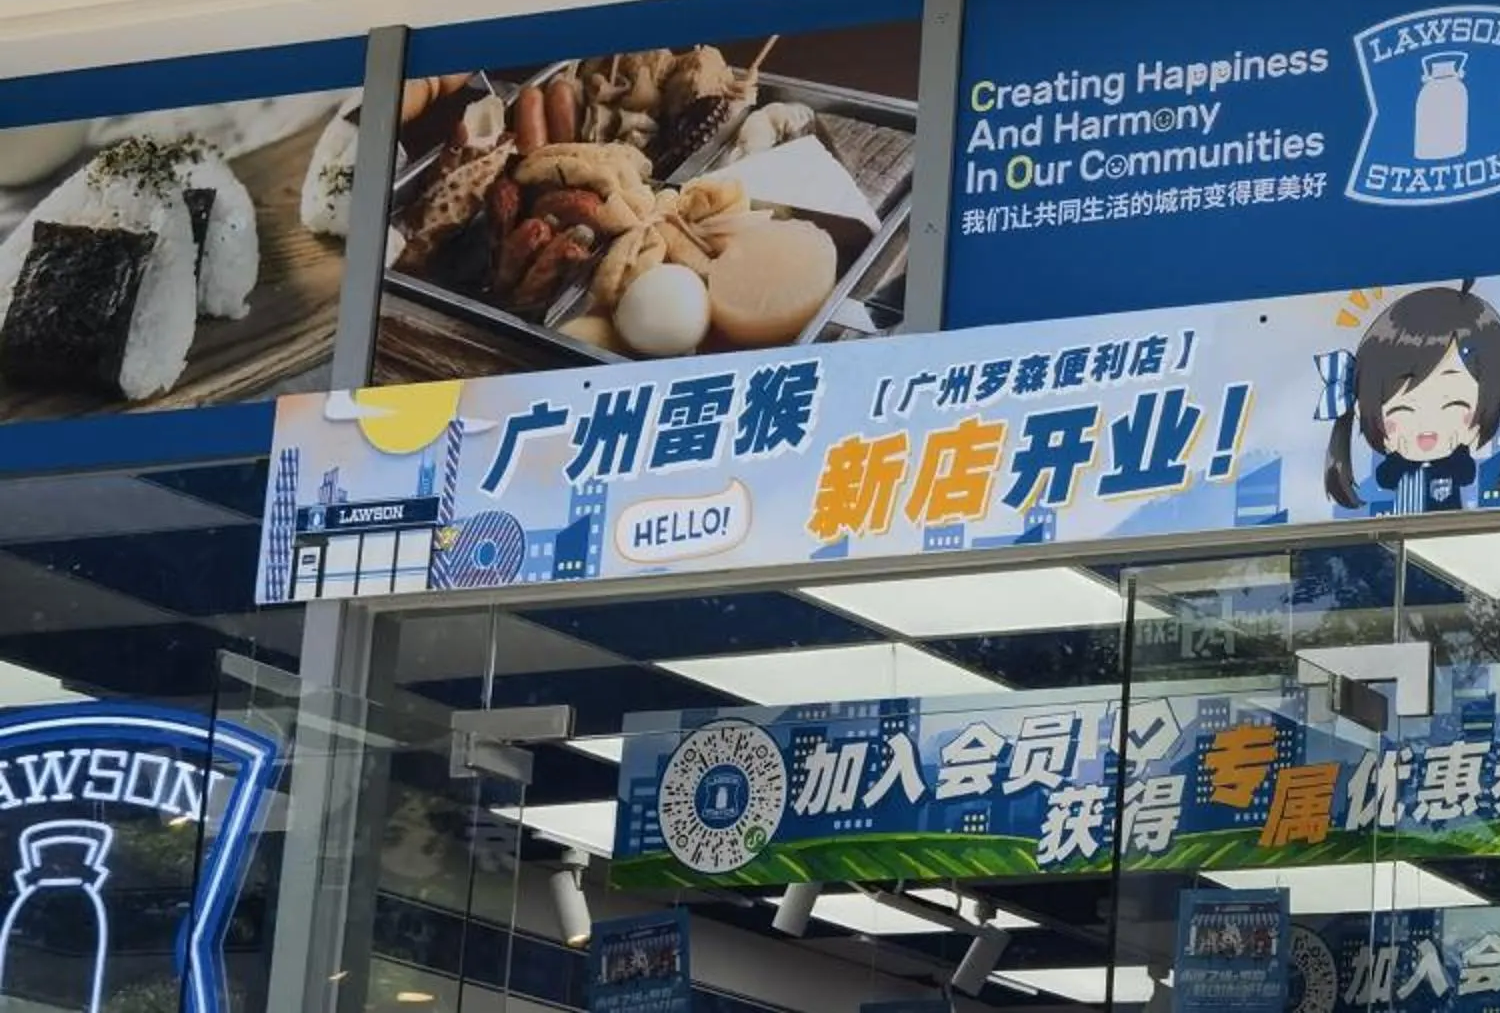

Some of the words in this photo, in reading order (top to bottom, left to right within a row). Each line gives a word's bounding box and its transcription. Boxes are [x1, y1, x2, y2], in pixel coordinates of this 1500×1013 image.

[971, 70, 1125, 112] Creating
[1137, 48, 1329, 93] Happiness
[967, 116, 1043, 153] And
[1055, 102, 1221, 144] Harmony
[966, 161, 998, 195] In
[1005, 155, 1072, 191] Our
[1080, 130, 1325, 181] Communities
[962, 172, 1327, 236] 我们让共同生活的城市变得更美好
[872, 330, 1195, 417] 【广州罗森便利店】
[480, 360, 819, 492] 广州雷猴
[339, 505, 405, 524] LAWSON
[634, 506, 731, 547] HELLO!
[793, 711, 1077, 816] 加入会员
